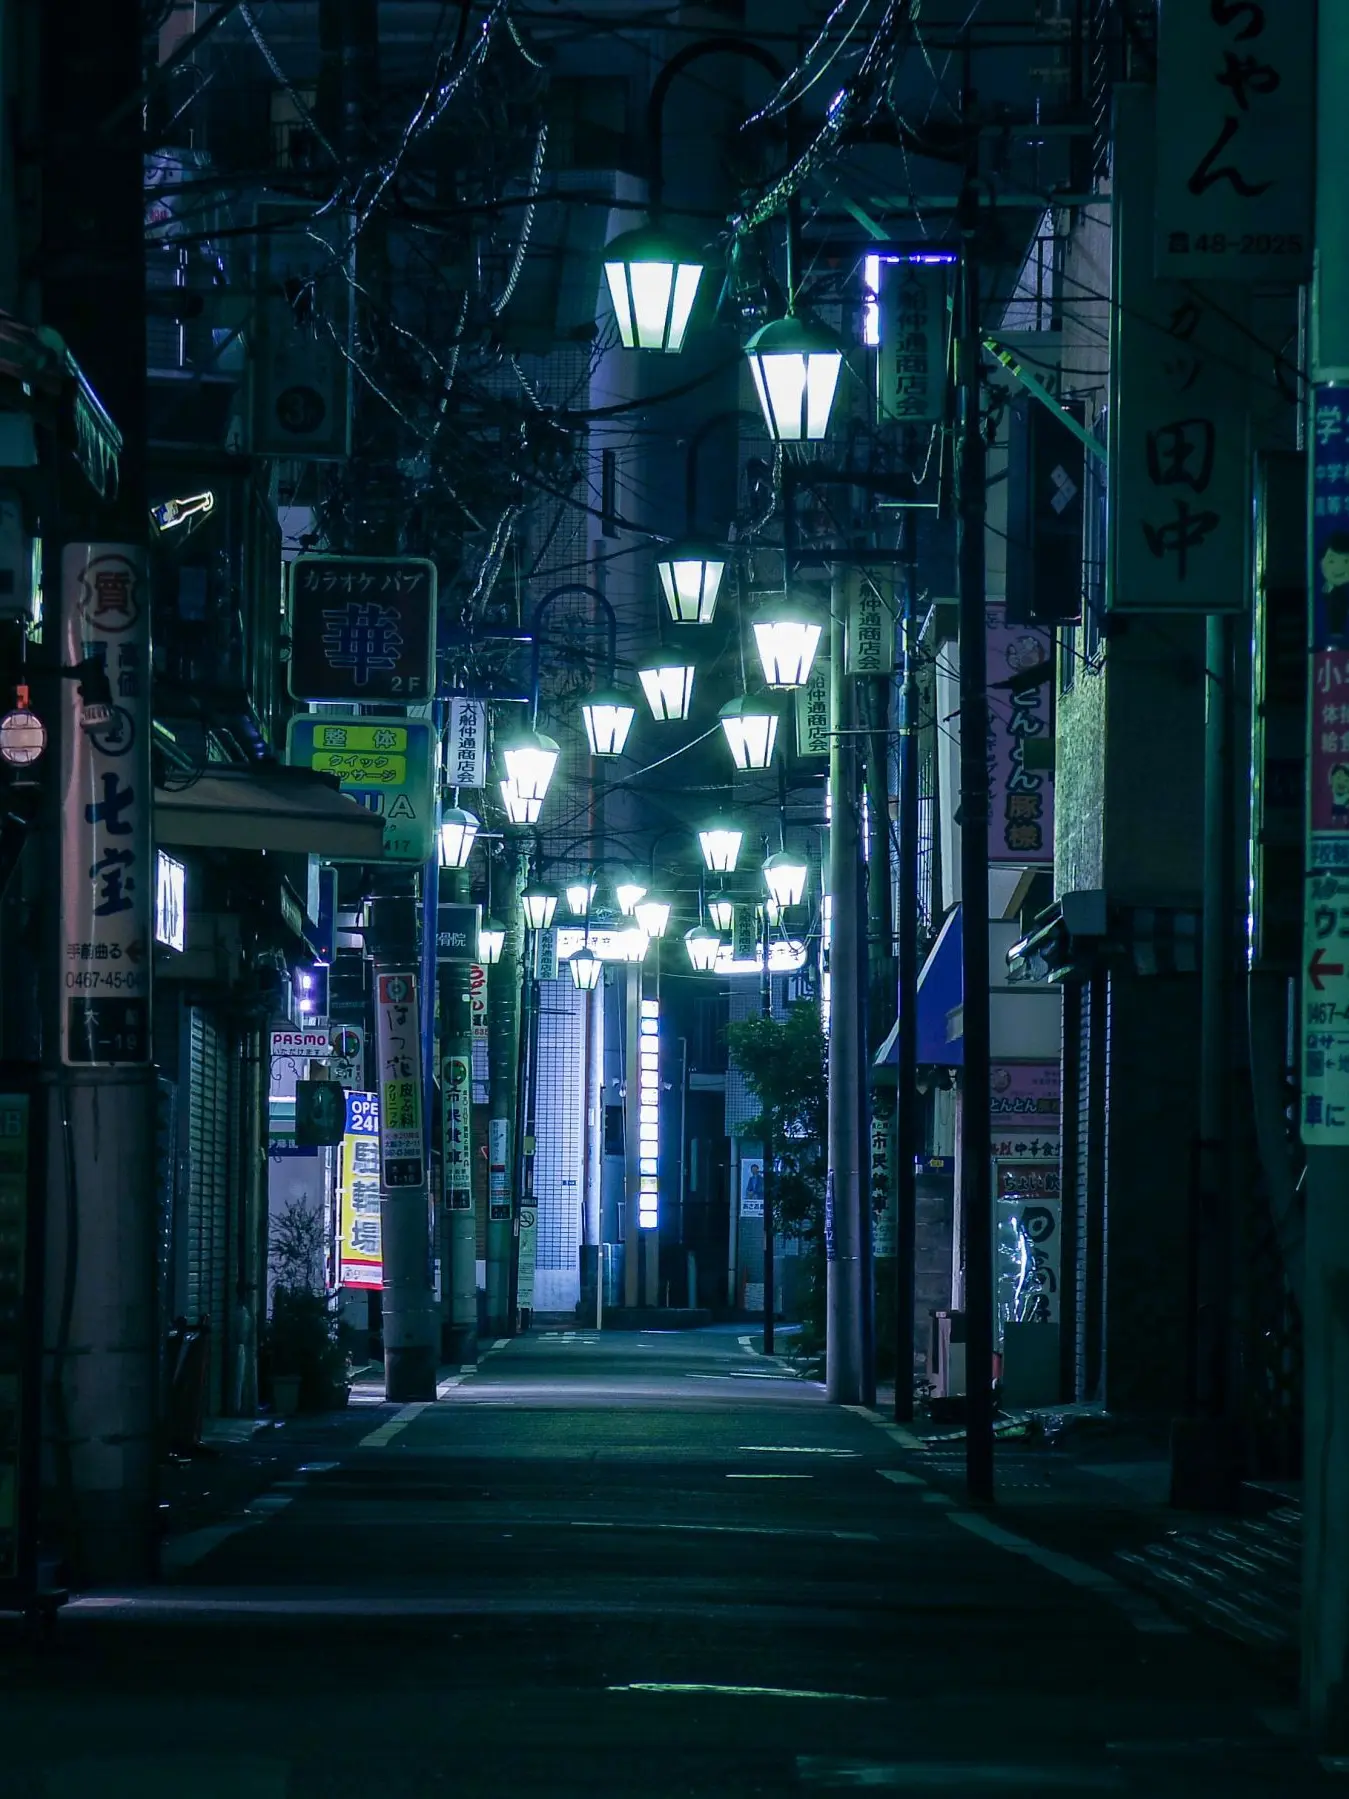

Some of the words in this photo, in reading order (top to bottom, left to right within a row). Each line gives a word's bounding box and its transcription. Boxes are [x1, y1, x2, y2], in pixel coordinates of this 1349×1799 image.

[1195, 232, 1302, 255] 48-2025
[1316, 405, 1349, 446] 学
[304, 569, 376, 593] カラオケ
[94, 571, 132, 616] 質
[320, 601, 404, 687] 華
[391, 676, 421, 693] 2F
[322, 727, 397, 749] 整体
[457, 703, 477, 784] 大船仲通商店会
[329, 754, 389, 767] クイック
[85, 772, 136, 916] 七宝
[273, 1034, 326, 1046] PASMO
[351, 1101, 379, 1116] OPE
